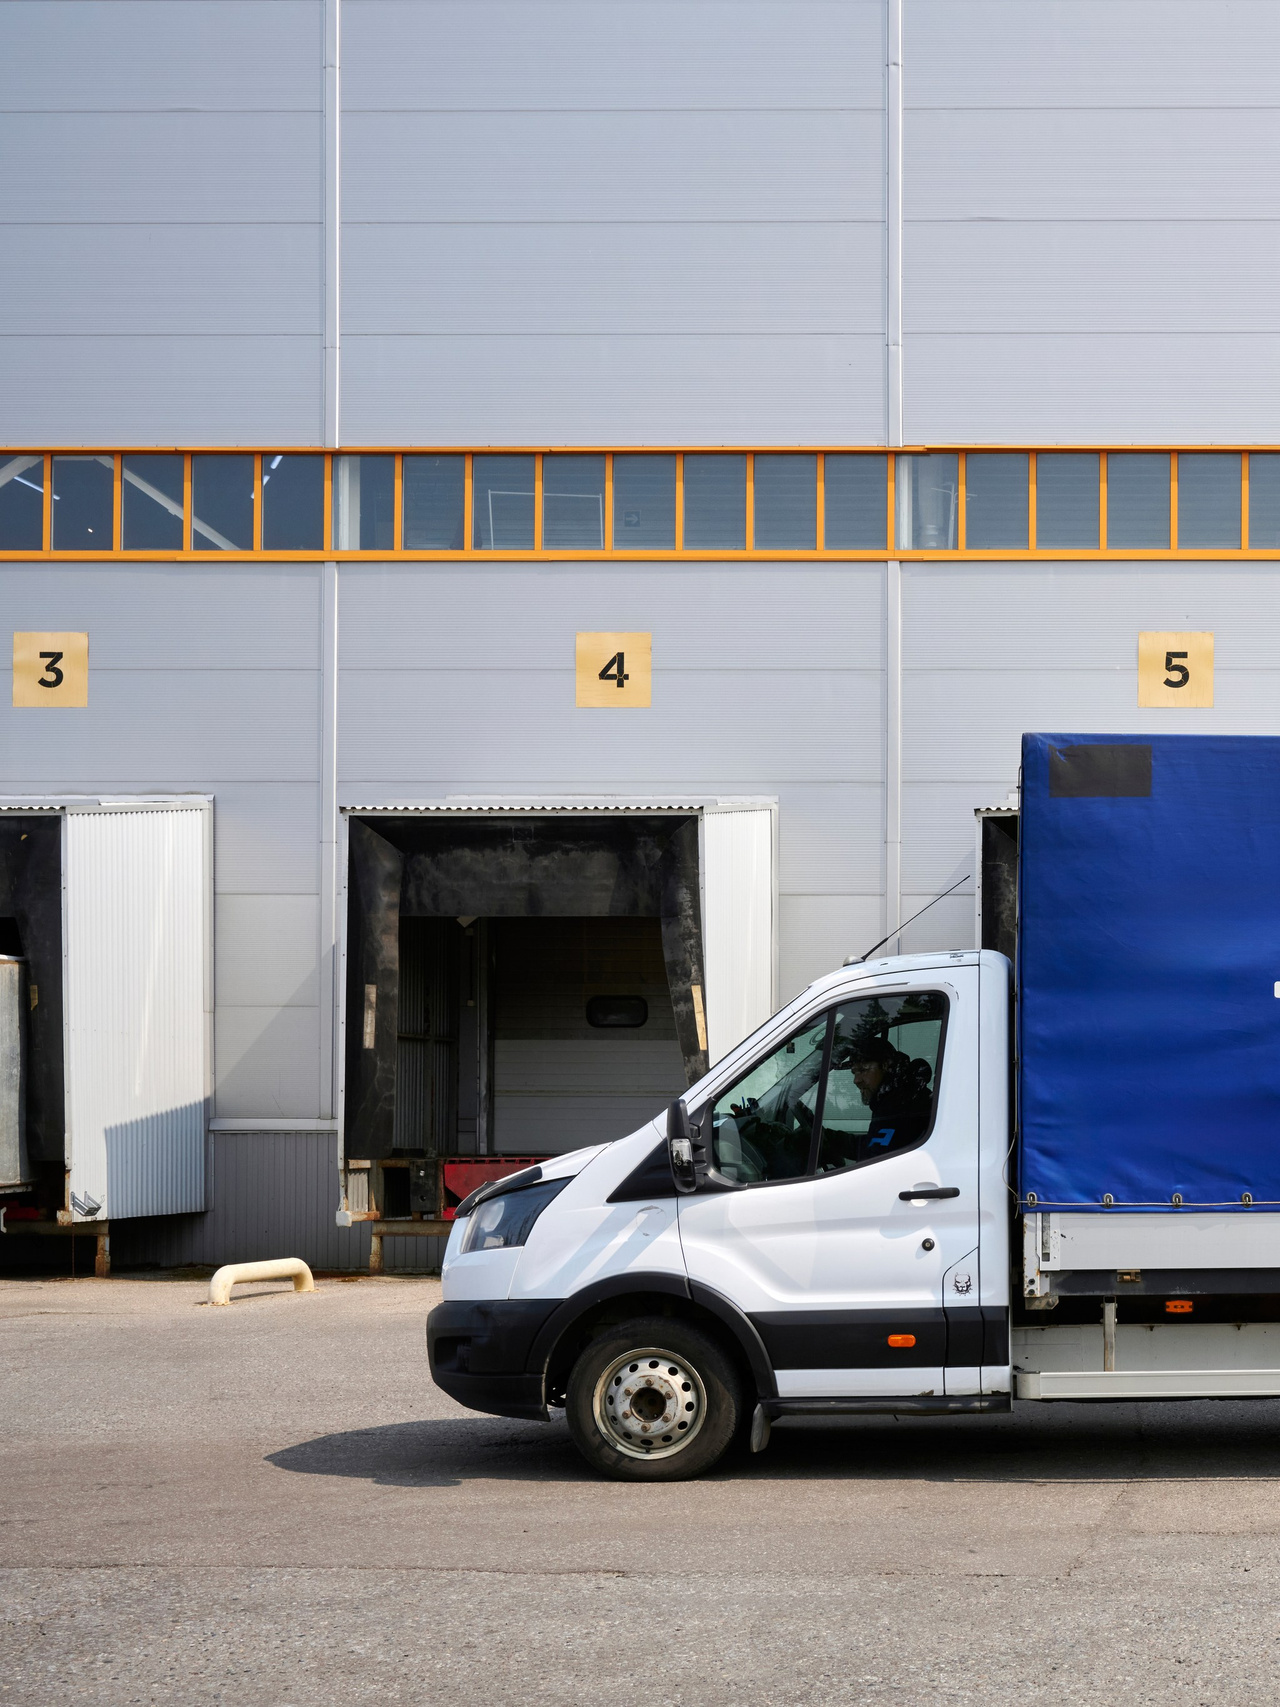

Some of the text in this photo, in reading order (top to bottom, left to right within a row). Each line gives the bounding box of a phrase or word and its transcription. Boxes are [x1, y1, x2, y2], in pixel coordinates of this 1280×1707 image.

[37, 651, 64, 688] 3
[598, 651, 629, 688] 4
[1163, 651, 1190, 688] 5
